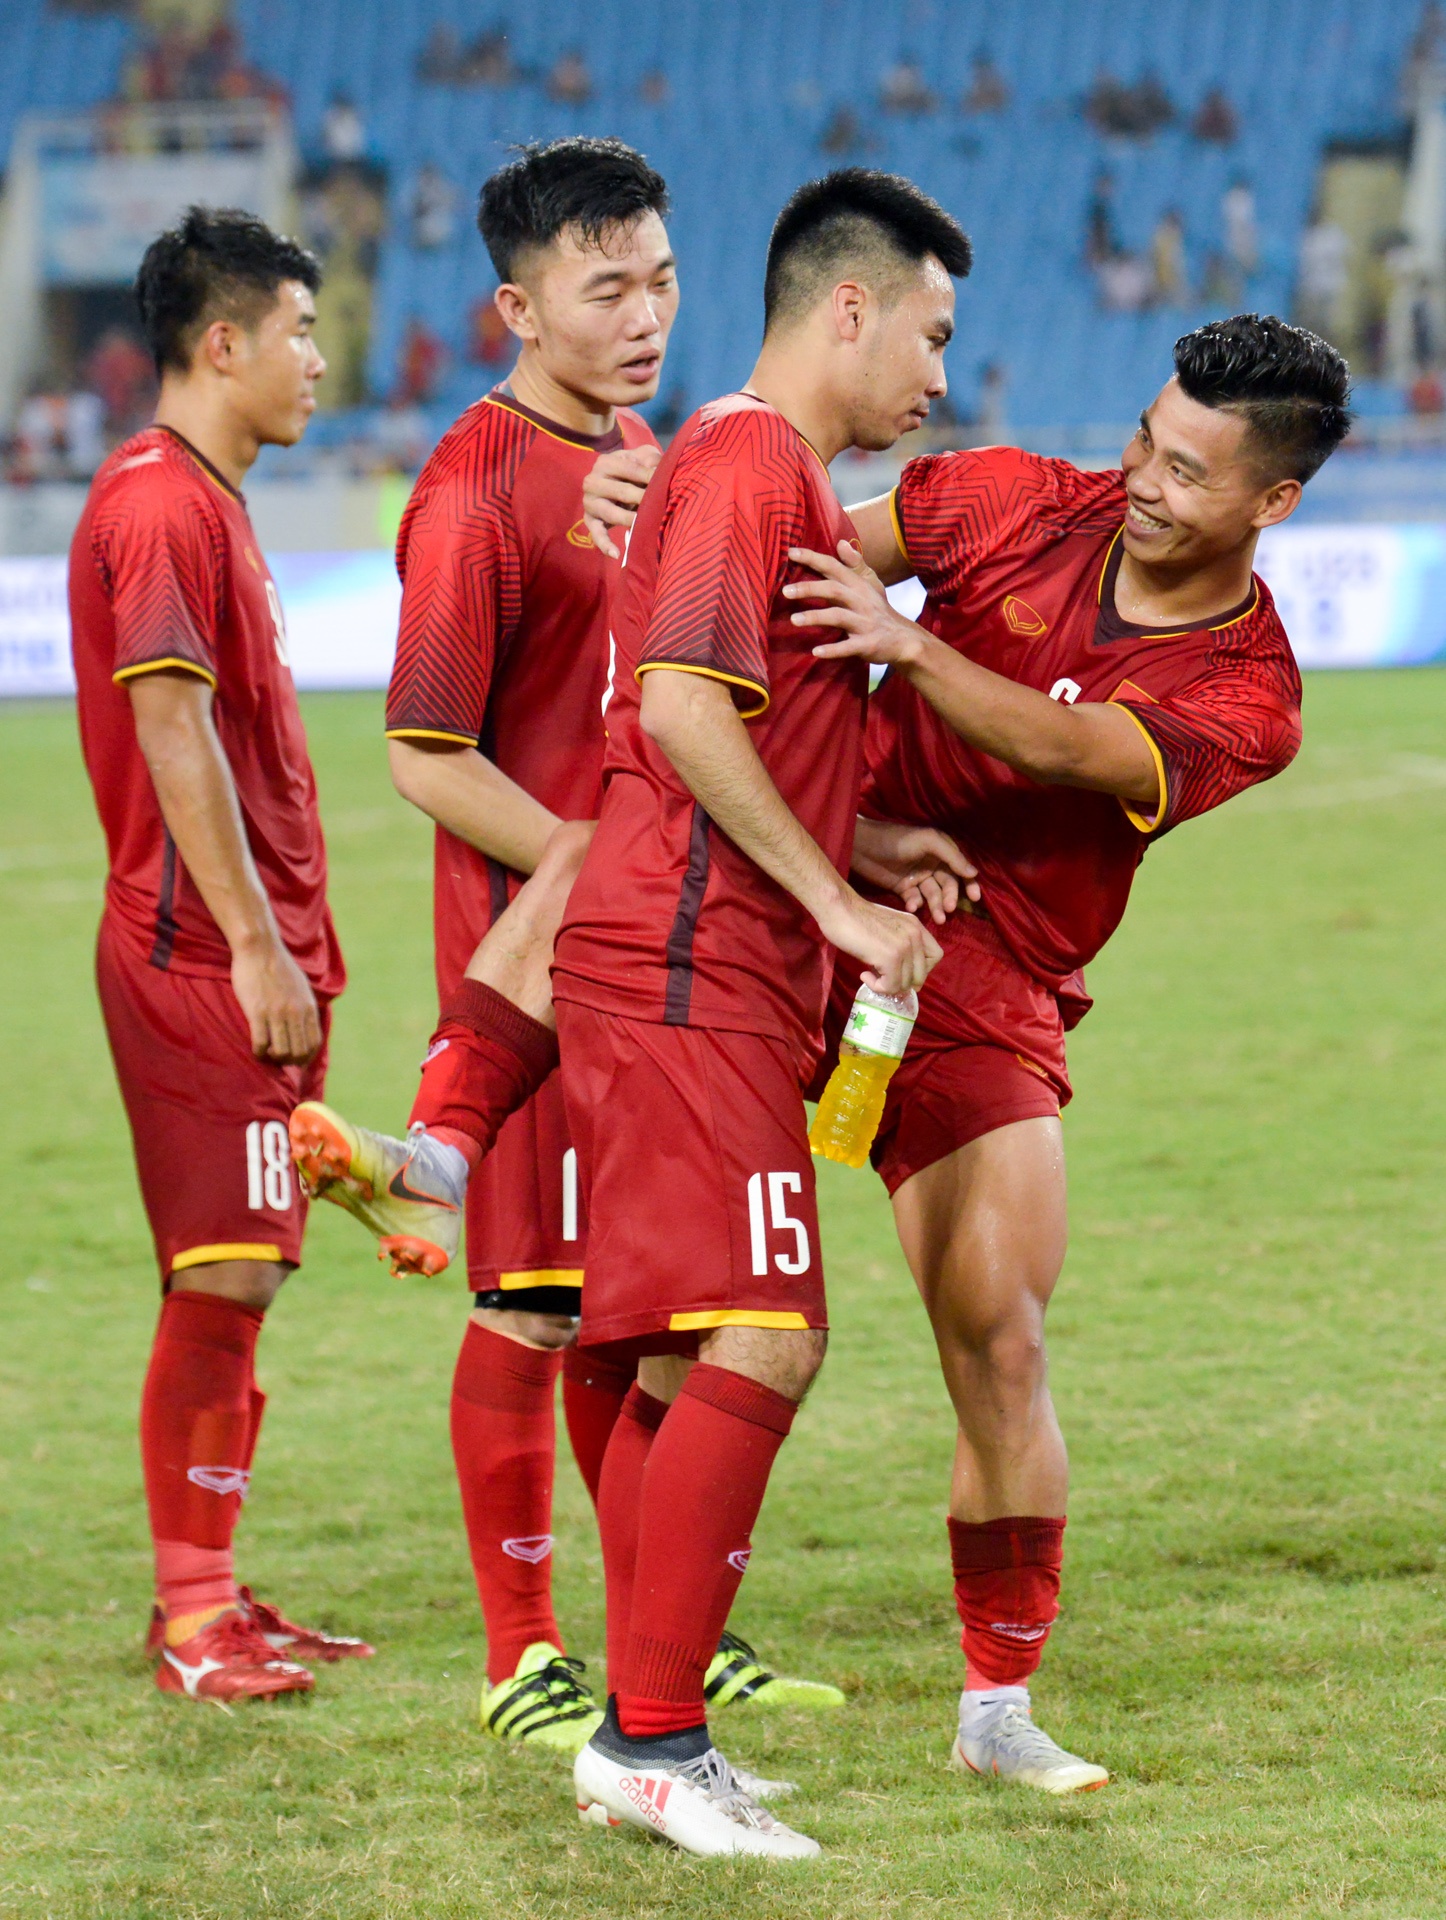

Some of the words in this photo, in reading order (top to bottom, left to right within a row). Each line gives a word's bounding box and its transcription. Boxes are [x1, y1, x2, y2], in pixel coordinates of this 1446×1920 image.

[246, 1121, 291, 1211] 18
[747, 1171, 811, 1276] 15
[619, 1776, 668, 1832] adidas
